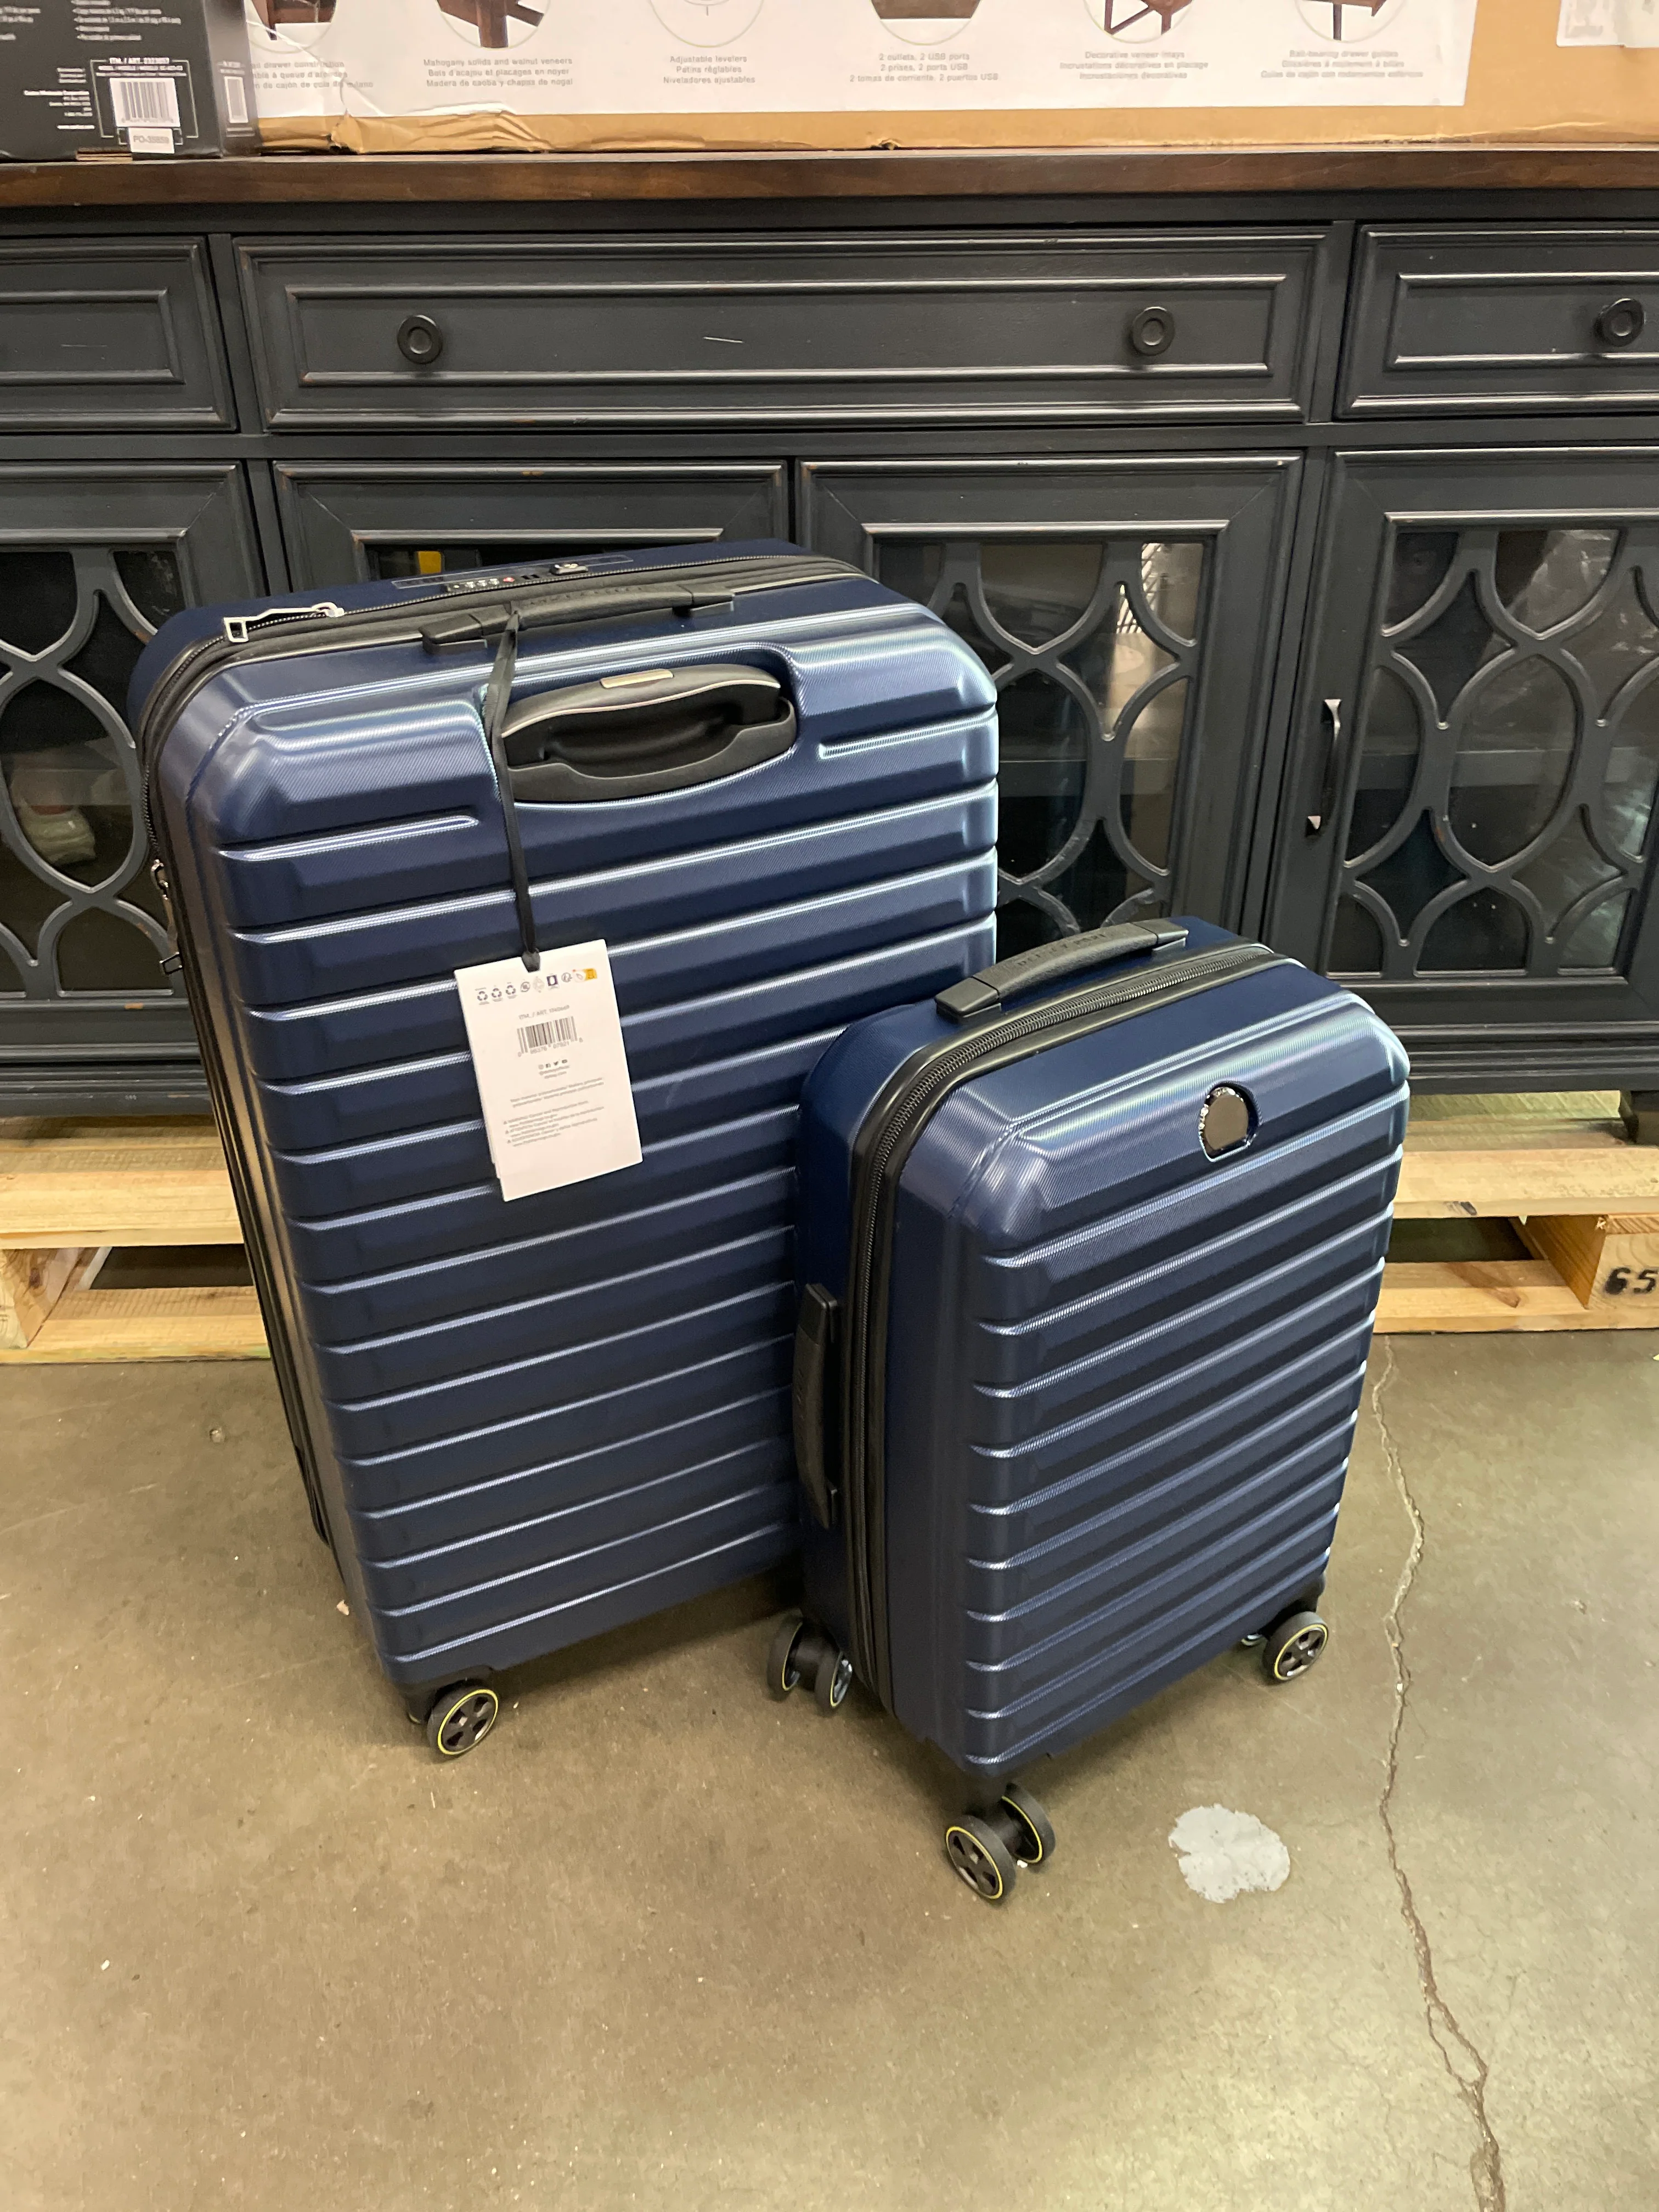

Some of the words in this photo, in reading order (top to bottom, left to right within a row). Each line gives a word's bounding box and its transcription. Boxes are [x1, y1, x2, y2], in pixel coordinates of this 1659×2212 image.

[670, 55, 712, 64] Adjustable
[949, 53, 969, 61] ports
[424, 59, 465, 67] Mahogany
[704, 66, 742, 74] réglables
[888, 64, 916, 72] prises,
[926, 64, 947, 72] ports
[496, 69, 532, 77] placages
[547, 69, 569, 77] noyer
[507, 78, 535, 87] chapas
[551, 78, 573, 87] nogal
[714, 76, 755, 84] ajustables
[1604, 1267, 1658, 1295] 65
